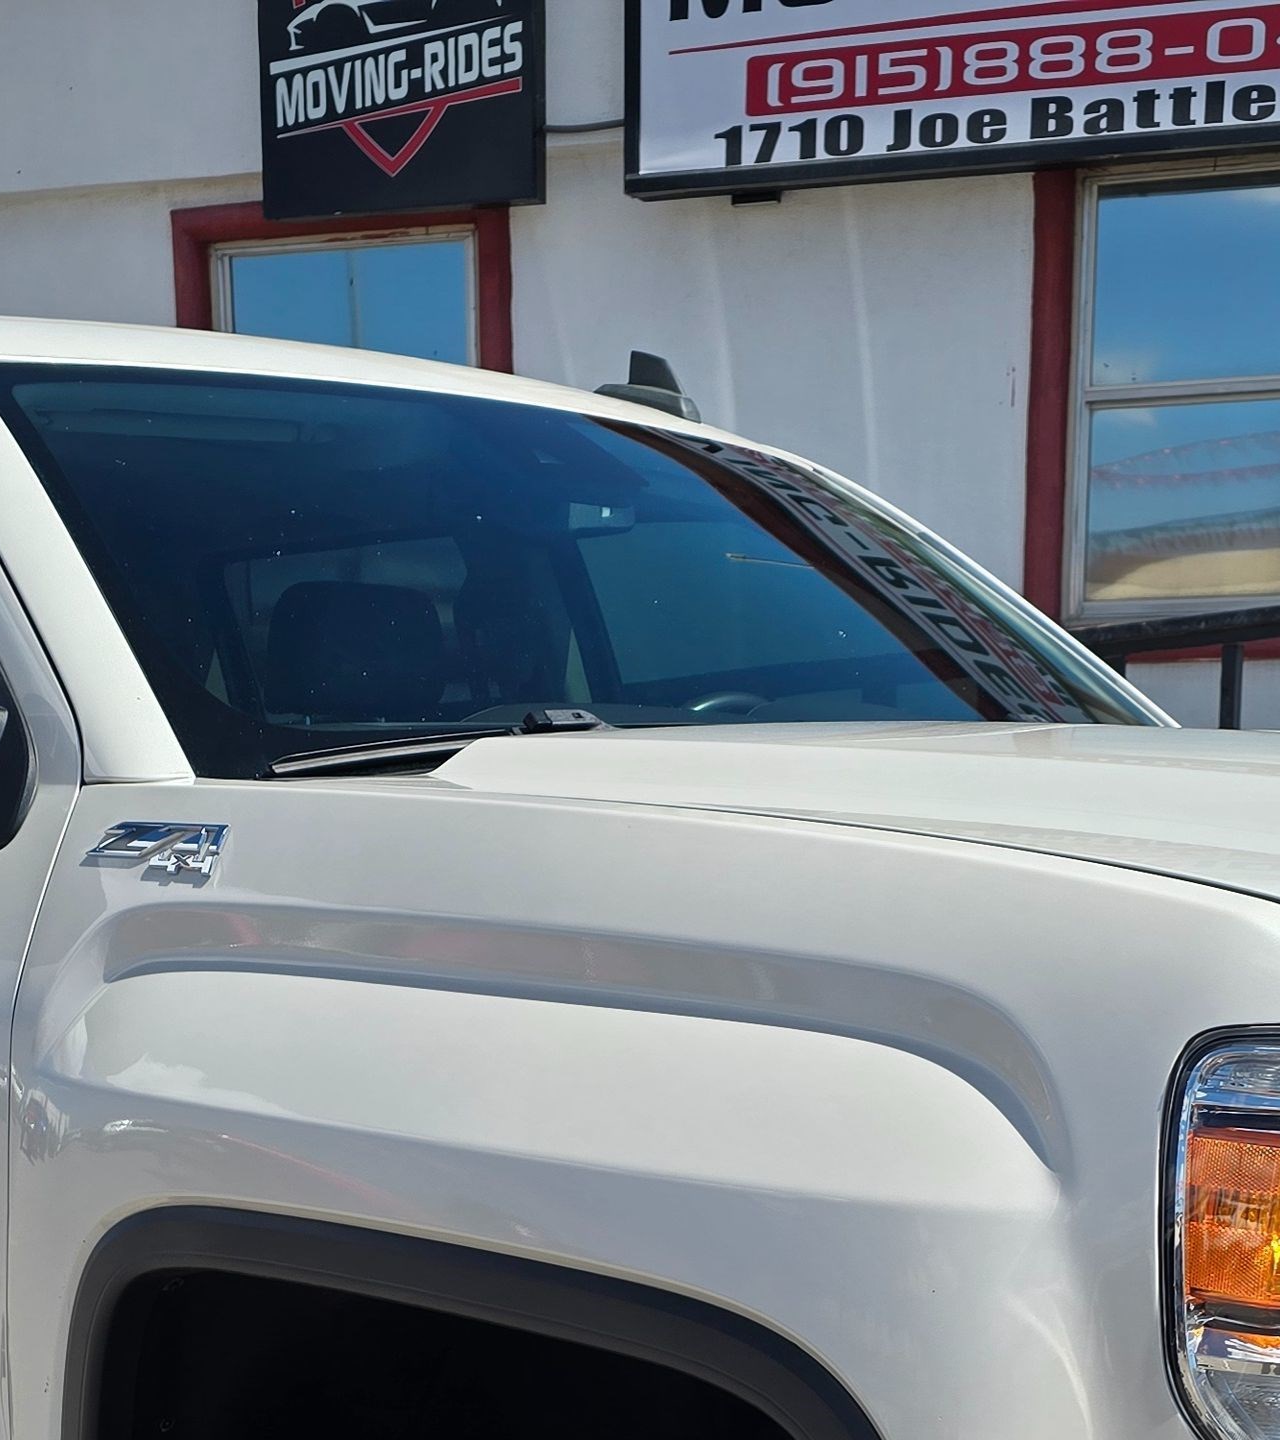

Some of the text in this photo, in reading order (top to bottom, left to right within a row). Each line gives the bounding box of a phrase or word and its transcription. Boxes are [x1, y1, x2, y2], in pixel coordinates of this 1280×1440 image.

[276, 21, 523, 128] MOVING-RIDES
[714, 114, 864, 167] 1710
[886, 107, 1007, 151] Joe
[1030, 80, 1277, 139] Battle
